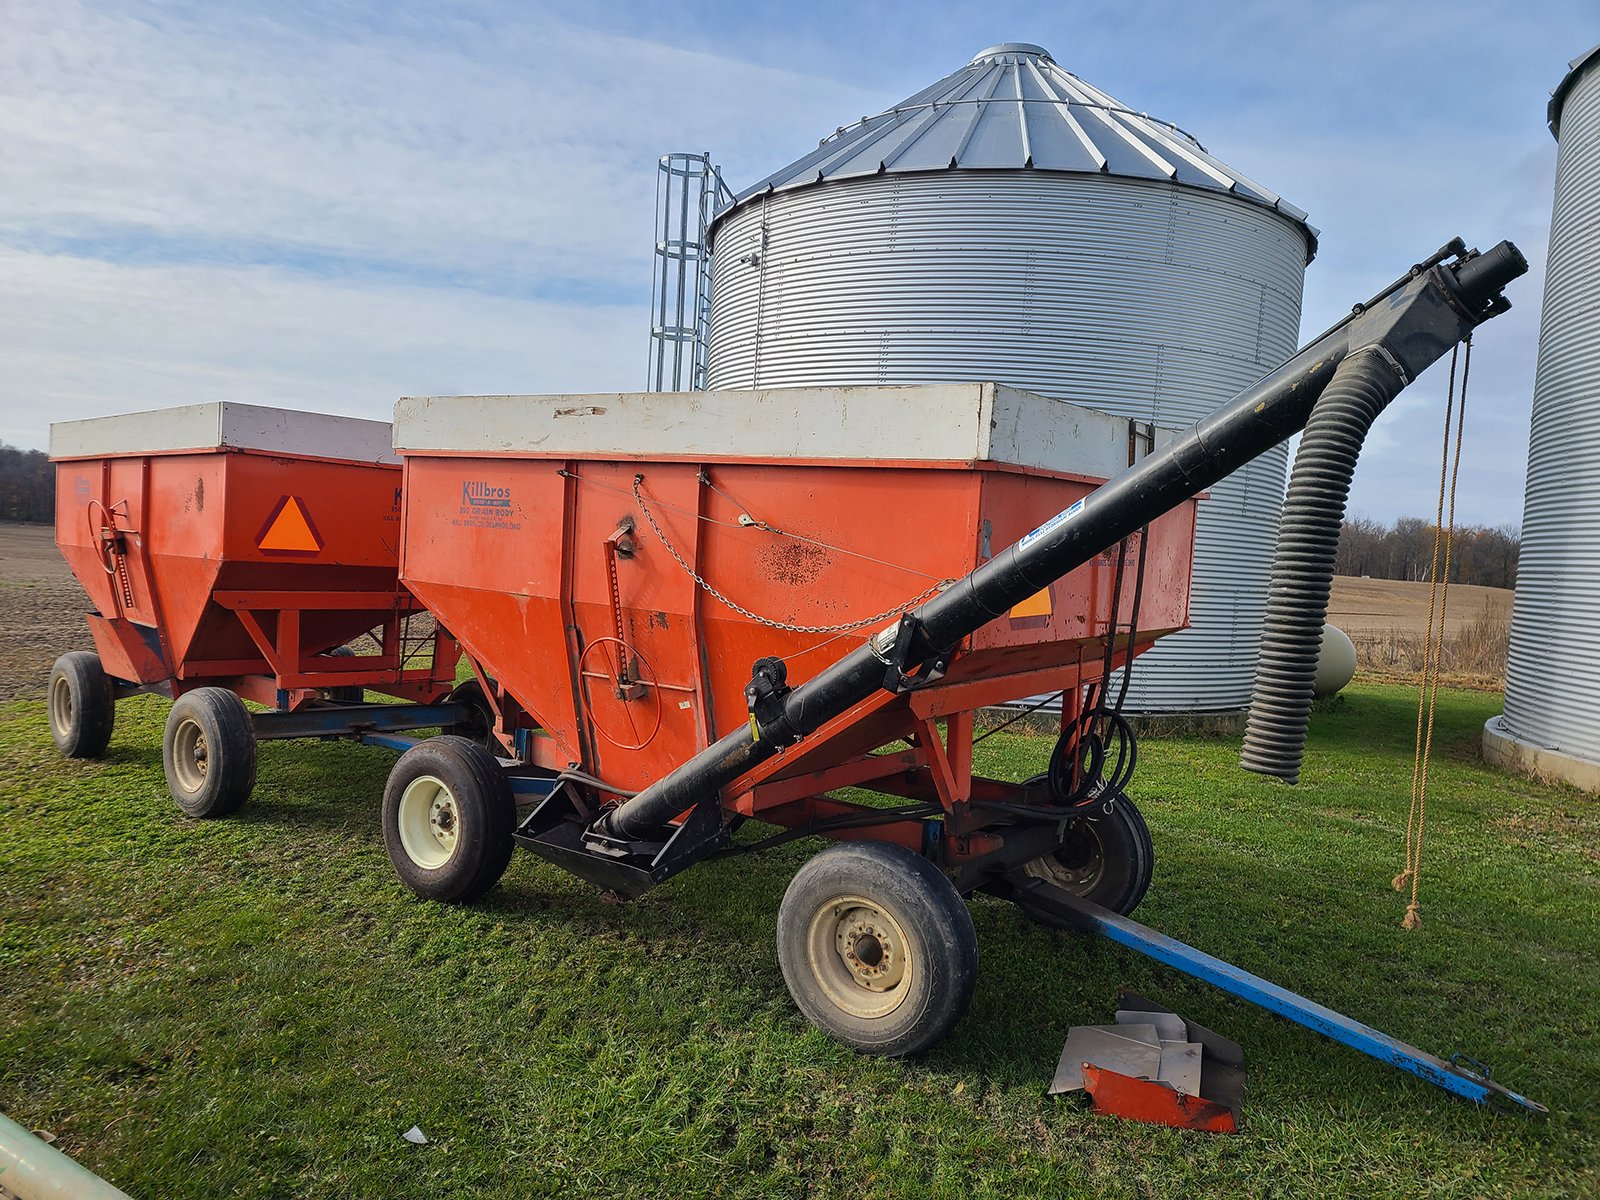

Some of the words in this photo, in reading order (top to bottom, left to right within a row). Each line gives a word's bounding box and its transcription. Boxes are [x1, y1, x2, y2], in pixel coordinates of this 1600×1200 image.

[463, 481, 511, 505] Killbros
[472, 508, 493, 516] GRAIN
[496, 509, 513, 517] BODY
